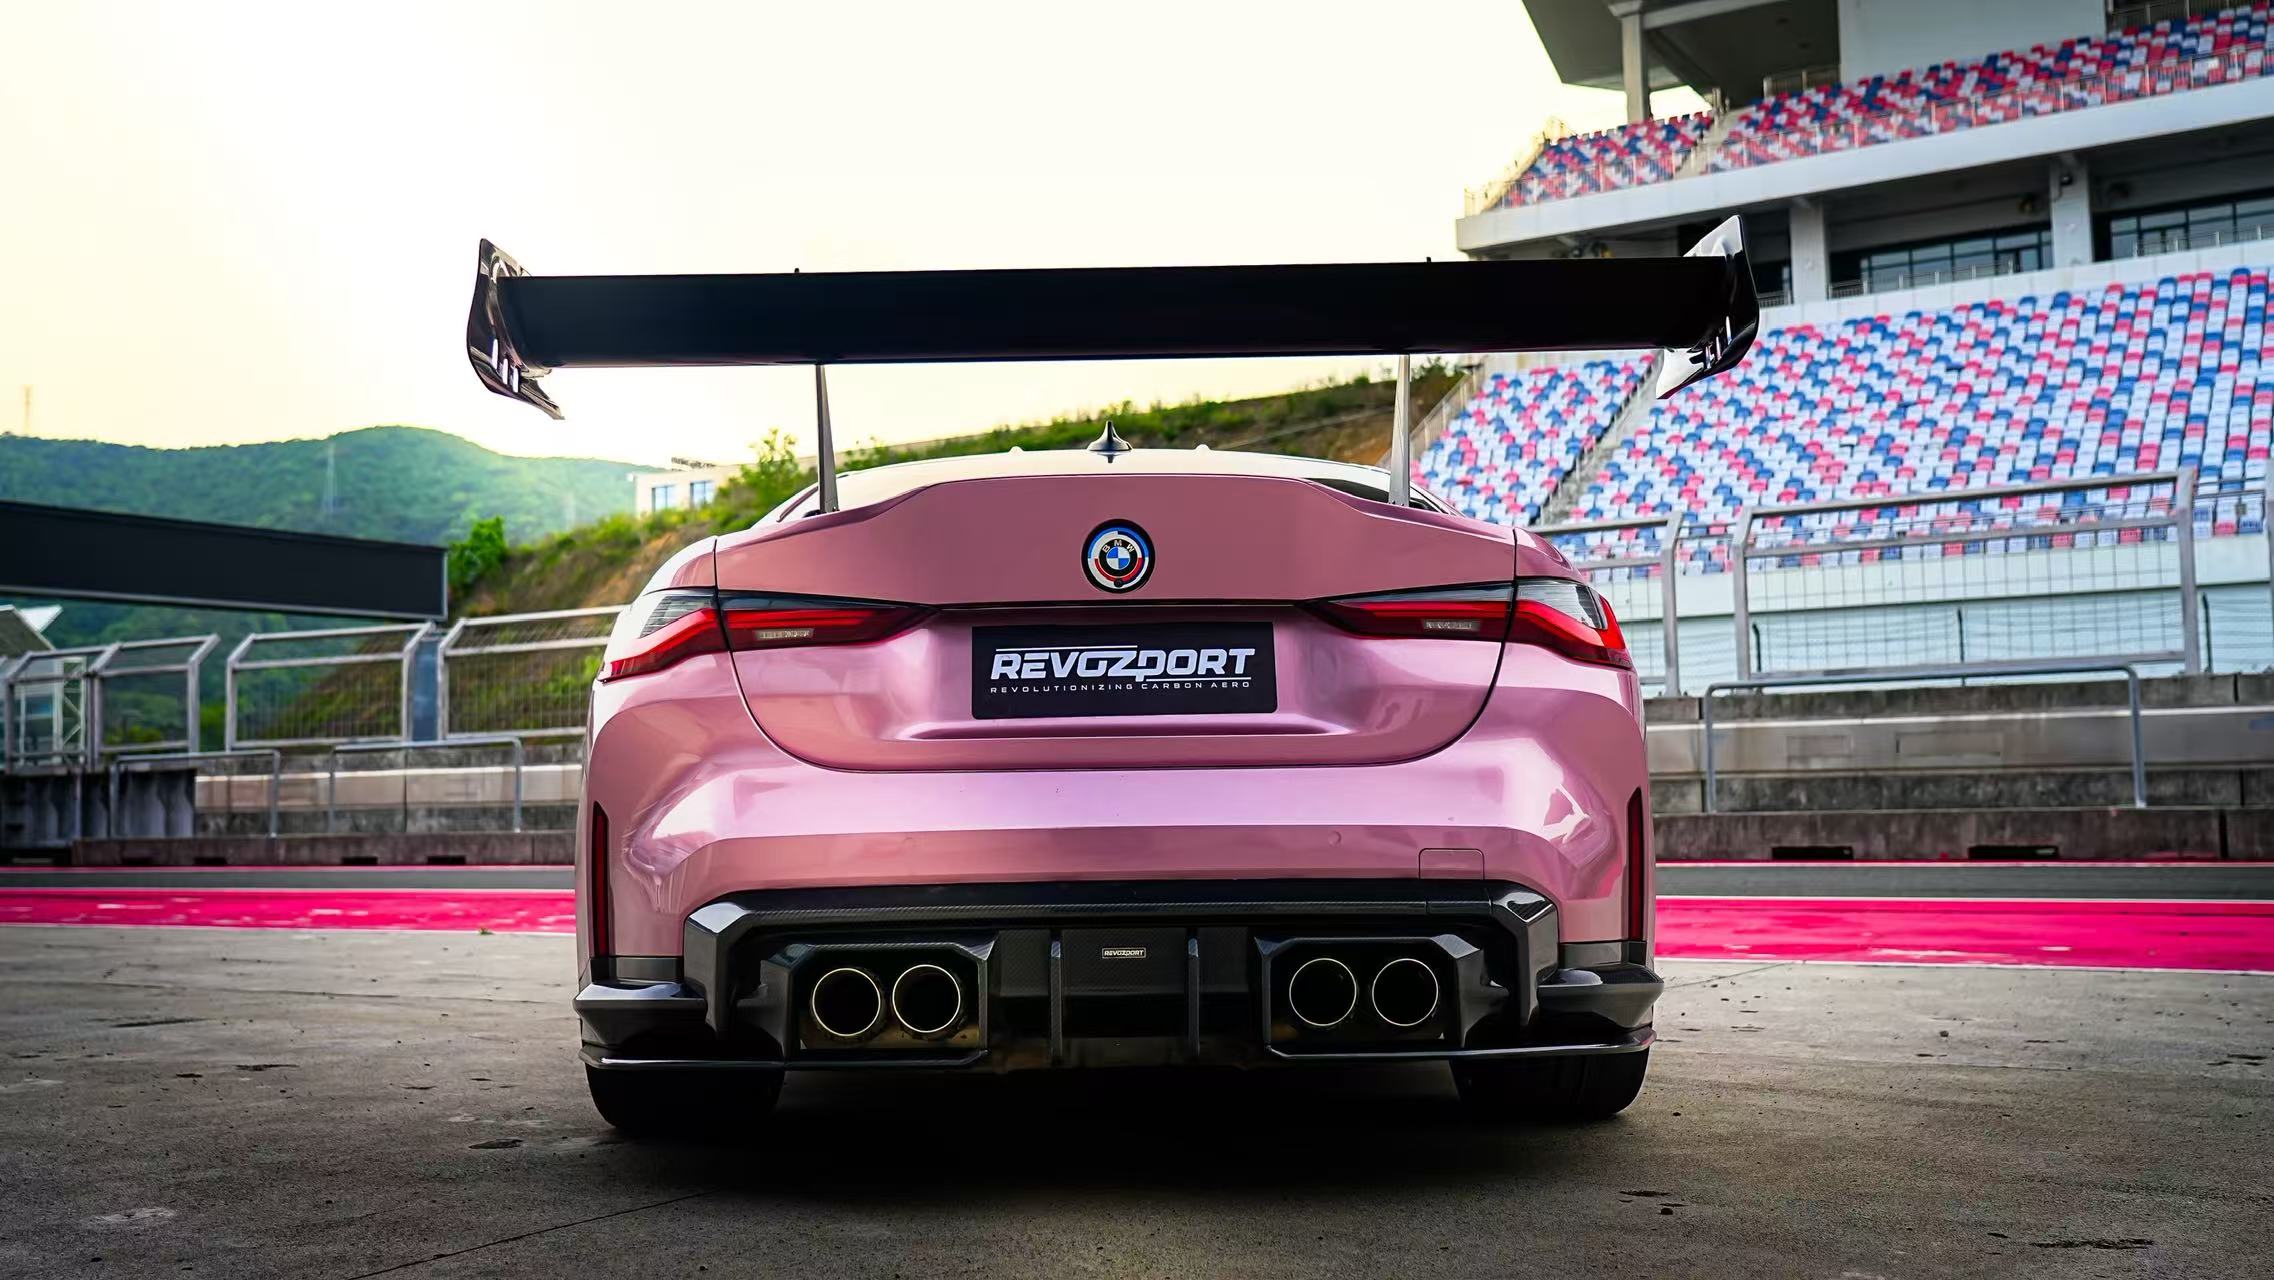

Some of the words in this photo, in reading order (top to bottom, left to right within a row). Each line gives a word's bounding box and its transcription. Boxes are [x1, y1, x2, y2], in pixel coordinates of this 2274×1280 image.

[1102, 540, 1135, 553] BMW
[990, 683, 1133, 694] REVOLUTIONIZING
[1141, 681, 1203, 690] CARBON
[1210, 680, 1250, 689] AERO
